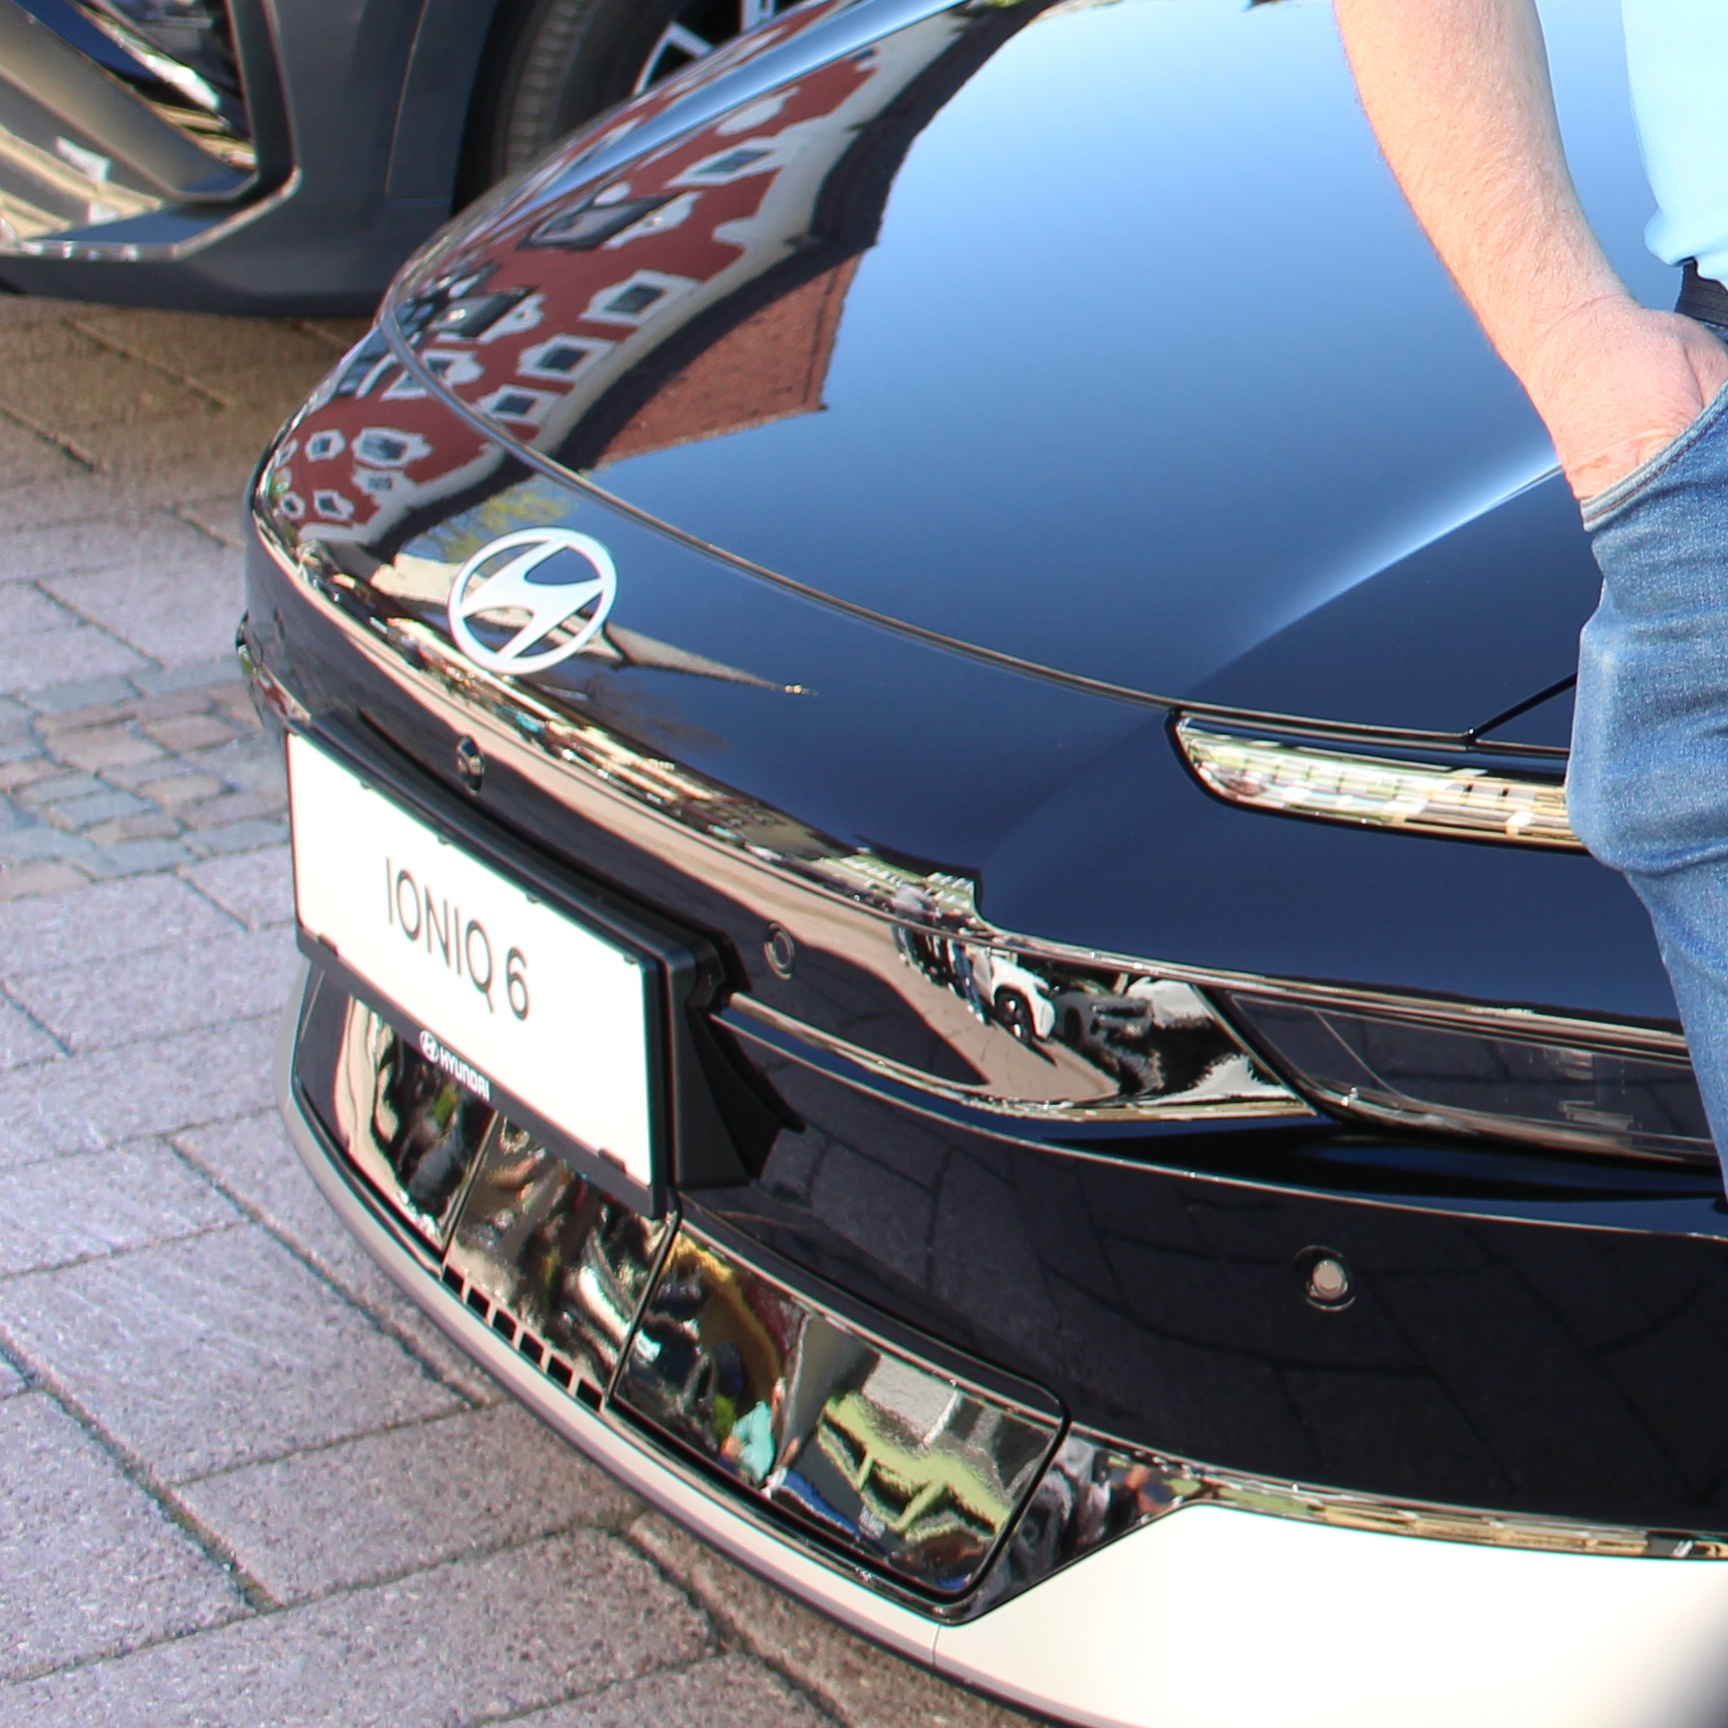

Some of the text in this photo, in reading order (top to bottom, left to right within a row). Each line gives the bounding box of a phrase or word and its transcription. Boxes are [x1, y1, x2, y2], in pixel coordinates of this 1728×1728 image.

[385, 856, 530, 1022] IONIQ 6
[440, 1045, 491, 1103] HYUNDAI
